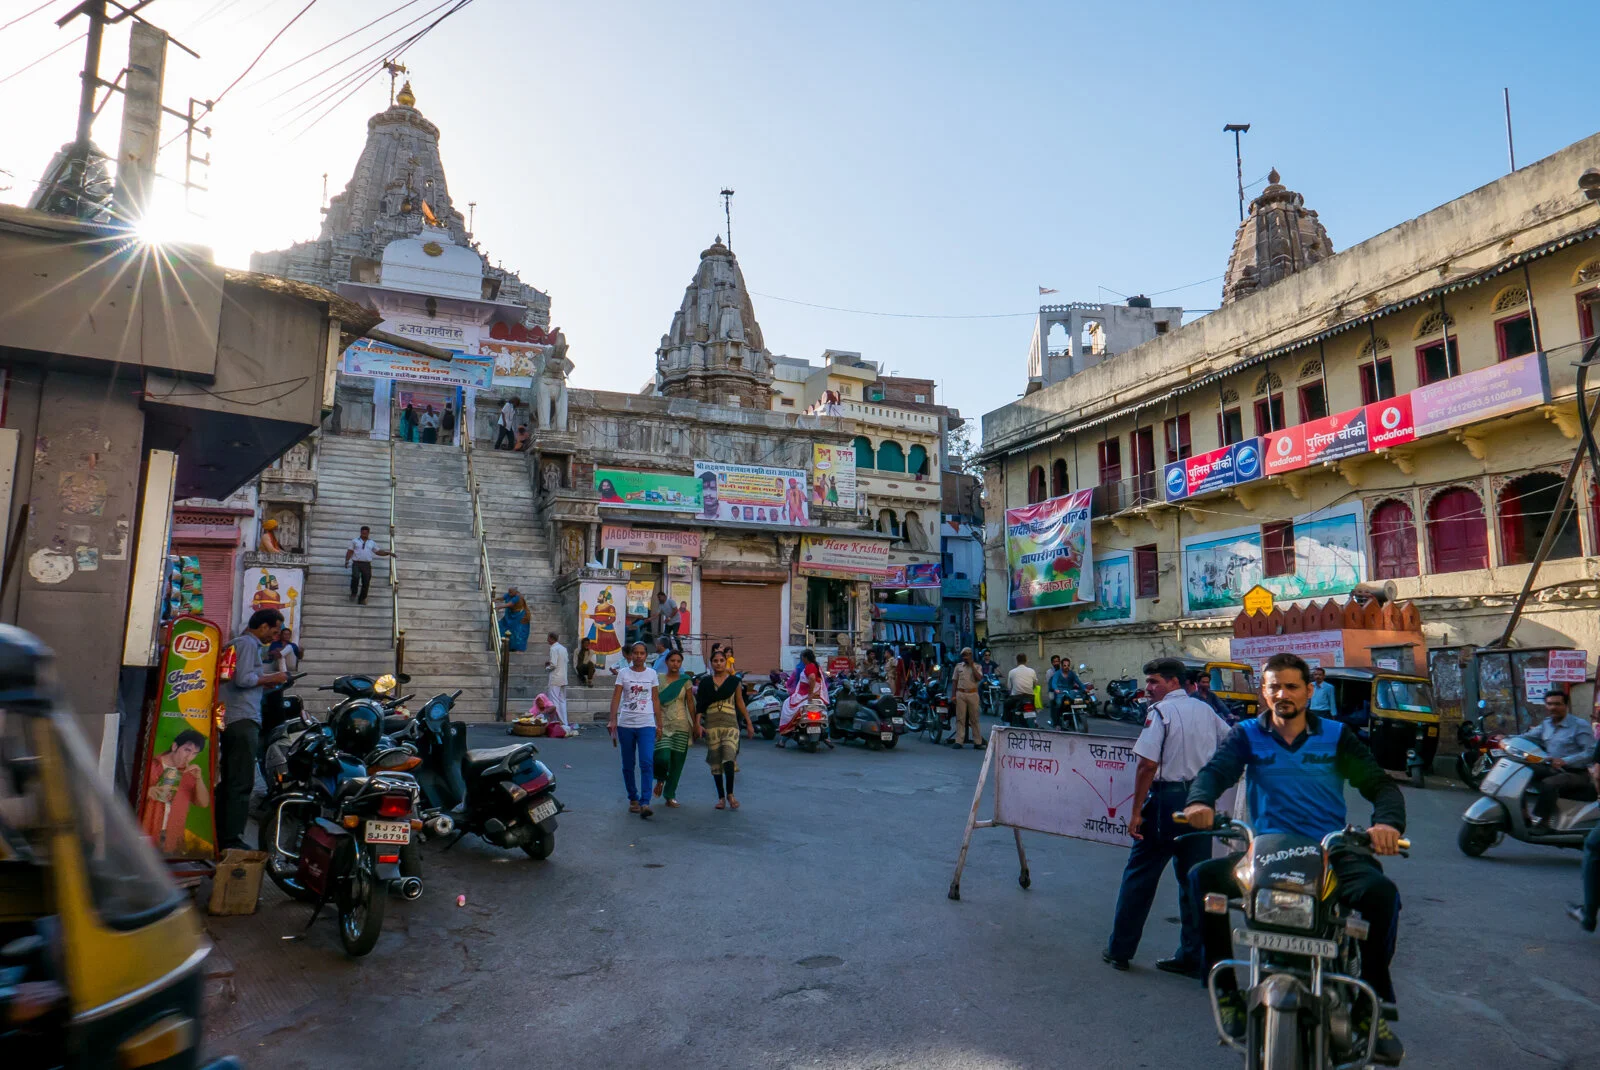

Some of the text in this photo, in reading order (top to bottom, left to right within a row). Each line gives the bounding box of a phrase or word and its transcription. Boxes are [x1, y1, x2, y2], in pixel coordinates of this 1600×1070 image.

[407, 324, 423, 335] जय
[423, 325, 453, 338] जगदीश
[453, 327, 464, 338] हरे
[1306, 423, 1366, 452] पुलिस चौकी
[1372, 426, 1414, 443] vodafone
[1188, 462, 1210, 483] पुलिस
[1211, 455, 1233, 472] चौकी
[1268, 453, 1303, 469] vodafone
[604, 527, 699, 547] JAGDISH ENTERPRISES
[824, 539, 889, 555] Hare Krishna
[1007, 732, 1052, 753] सिटी पैलेस
[1000, 754, 1060, 776] (राज महल)
[1095, 759, 1126, 772] यातायात
